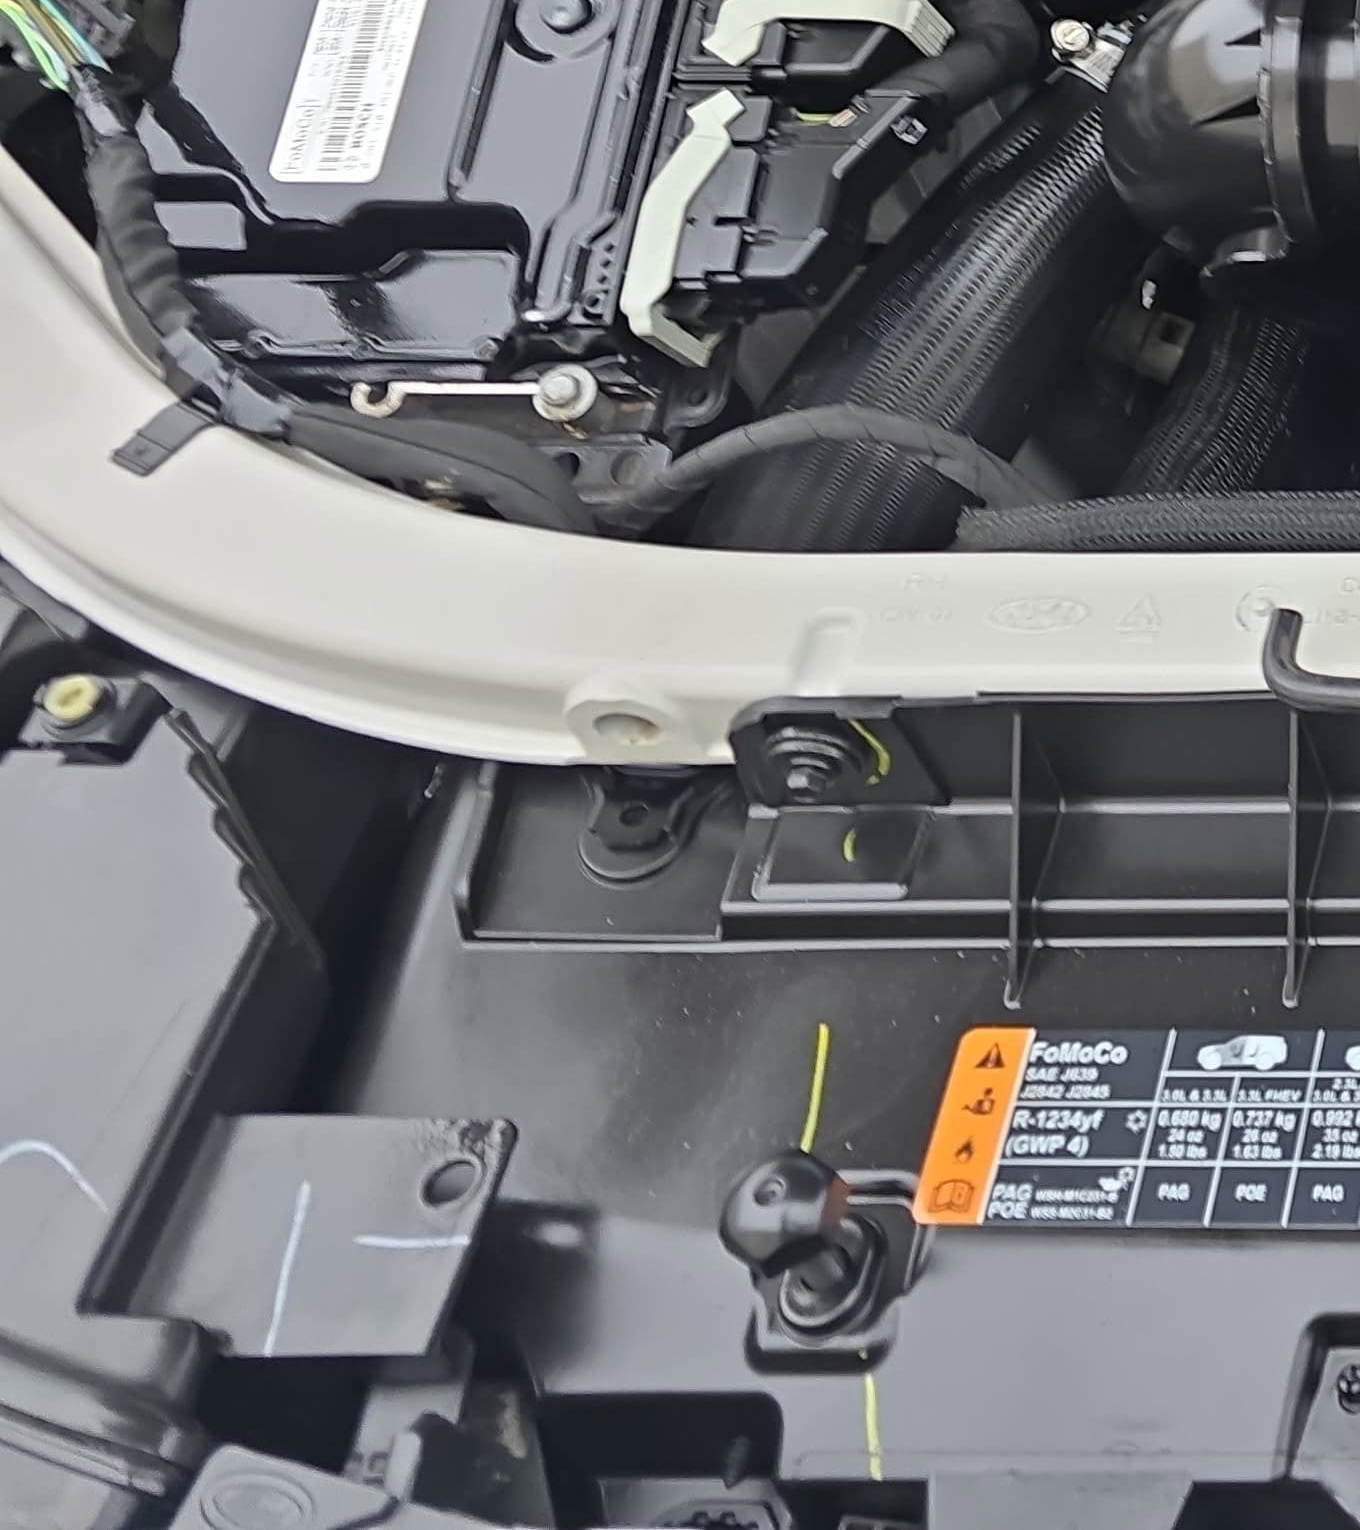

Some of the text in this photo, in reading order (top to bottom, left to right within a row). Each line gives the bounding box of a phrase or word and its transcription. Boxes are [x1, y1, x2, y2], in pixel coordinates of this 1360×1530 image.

[1029, 1041, 1128, 1064] FoMoCo
[1025, 1067, 1060, 1082] SAE
[1012, 1110, 1104, 1133] R-1234yf
[1201, 1109, 1222, 1132] kg
[1275, 1110, 1296, 1132] kg
[1005, 1134, 1089, 1158] (GWP 4)
[992, 1184, 1033, 1202] PAG
[1158, 1183, 1190, 1201] PAG
[1235, 1183, 1268, 1202] POE
[1312, 1184, 1344, 1202] PAG
[988, 1201, 1028, 1219] POE
